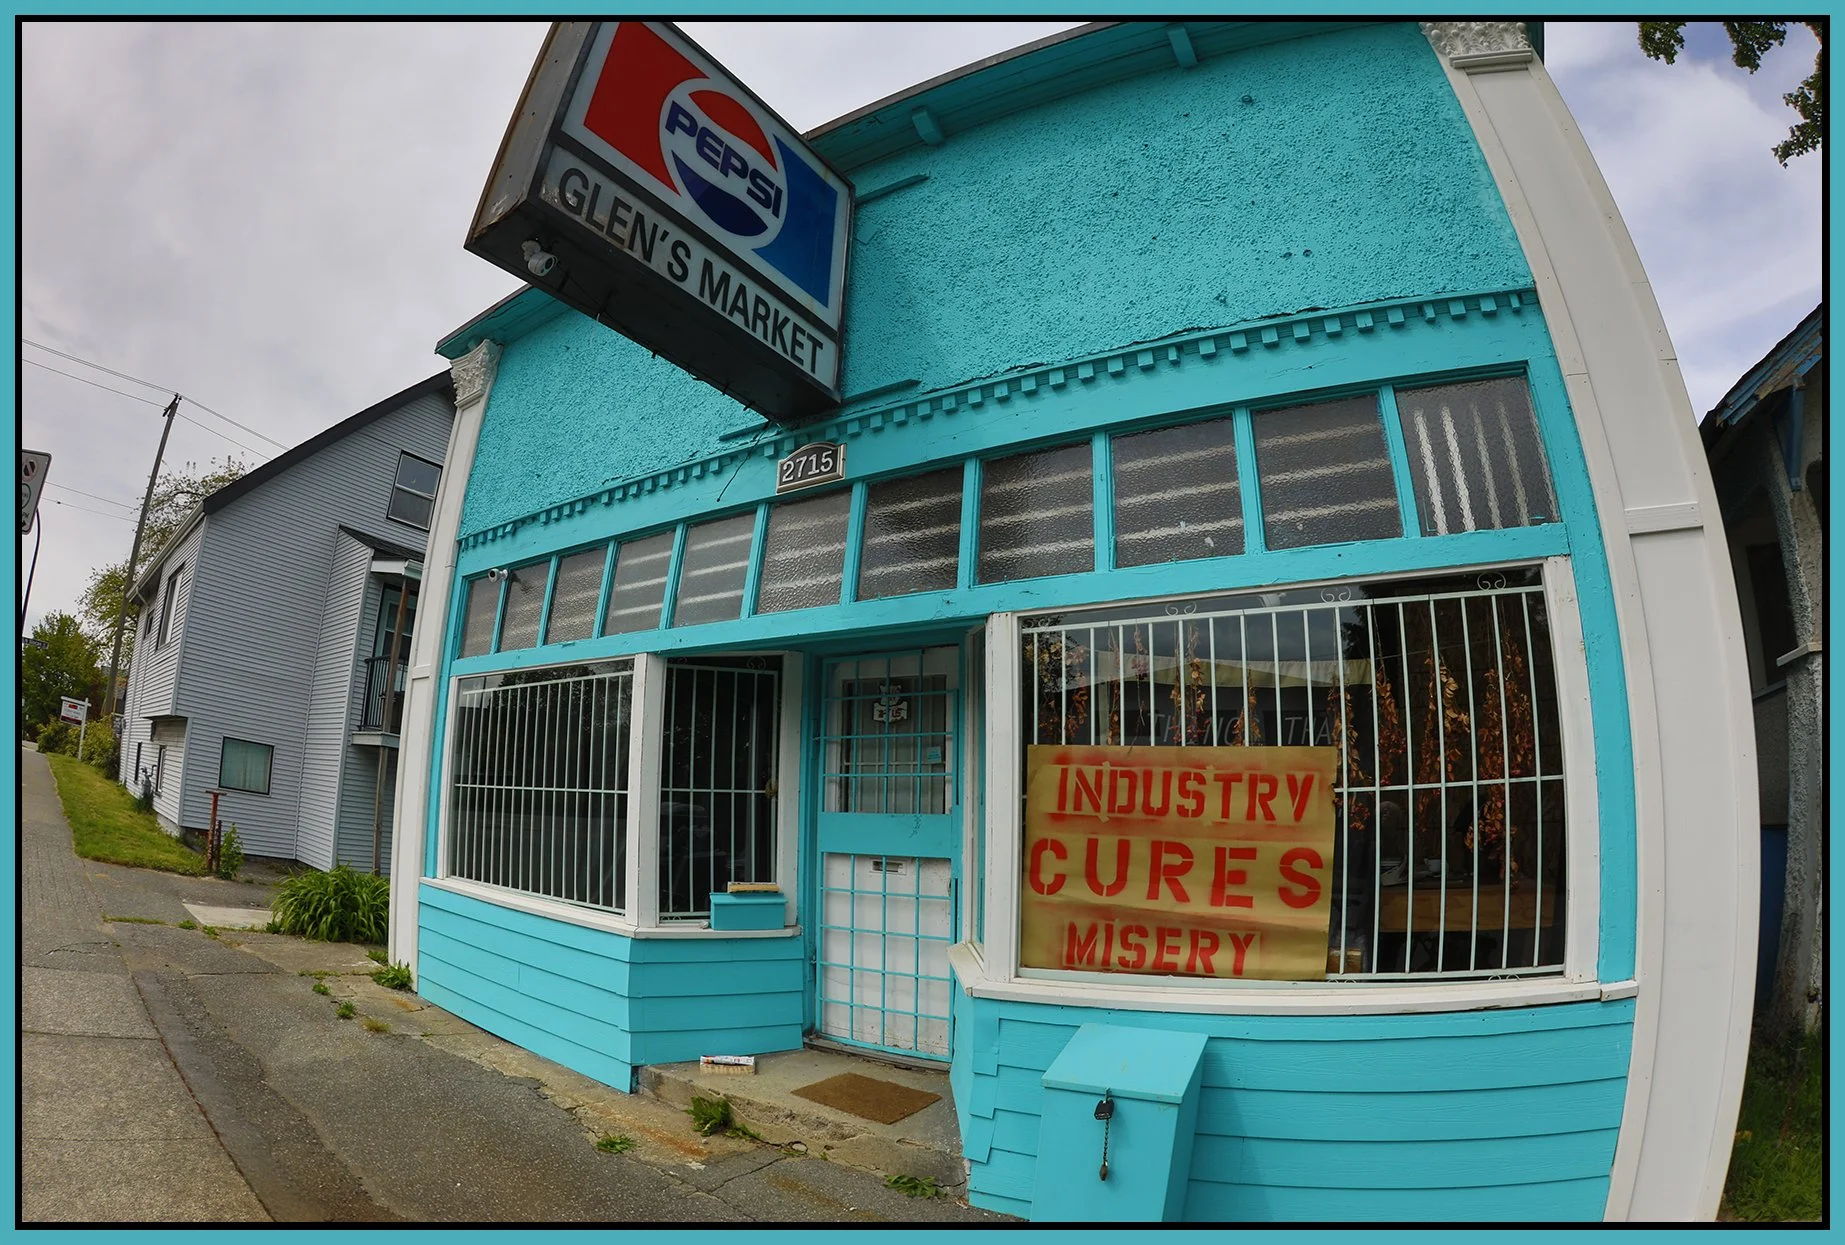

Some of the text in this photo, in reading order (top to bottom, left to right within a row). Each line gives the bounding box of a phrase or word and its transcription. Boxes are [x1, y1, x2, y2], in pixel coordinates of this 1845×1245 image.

[665, 100, 783, 219] PEPSI
[558, 167, 824, 374] GLEN'S MARKET
[782, 450, 834, 482] 2715
[1056, 766, 1315, 822] INDUSTRY
[1028, 837, 1324, 909] CURES
[1065, 921, 1256, 976] MISERY
